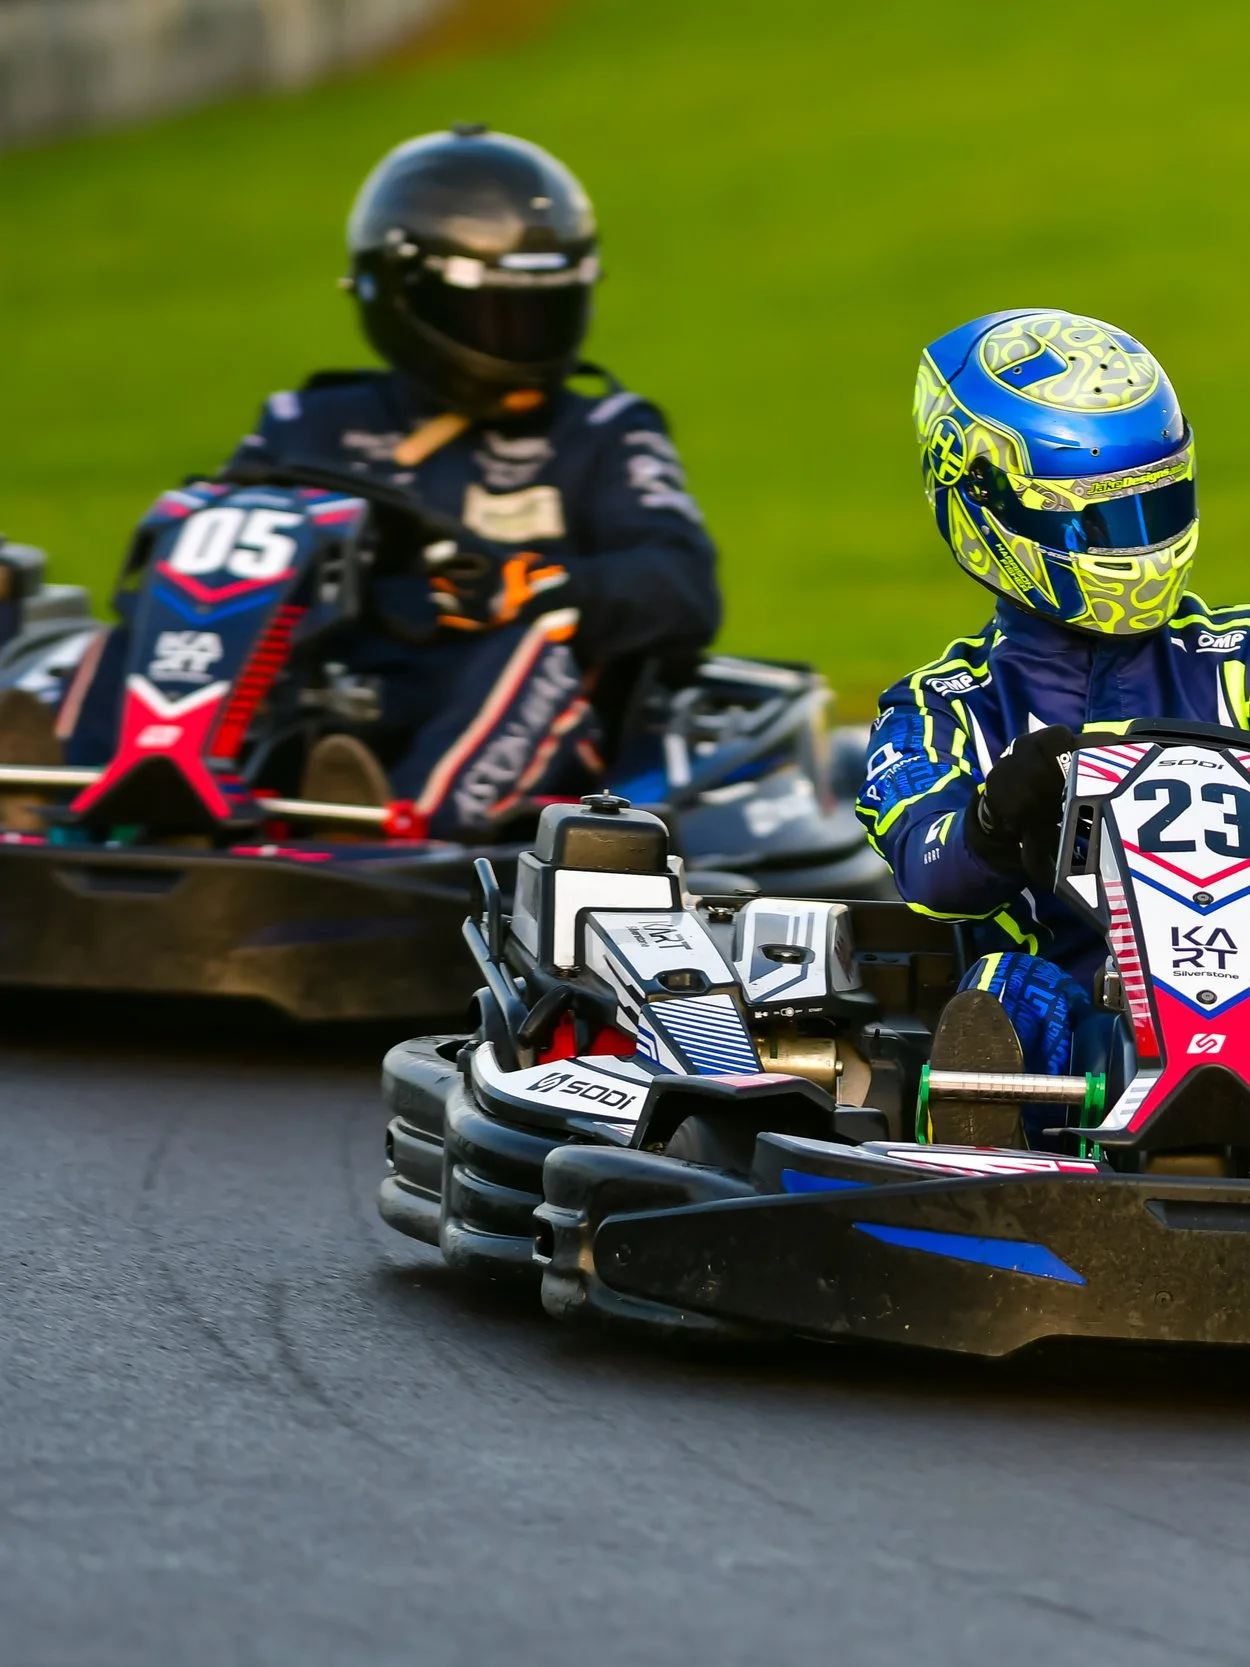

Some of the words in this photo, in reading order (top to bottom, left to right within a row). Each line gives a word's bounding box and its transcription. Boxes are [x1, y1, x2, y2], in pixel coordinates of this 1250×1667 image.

[170, 507, 304, 579] 05
[1198, 632, 1245, 649] OMP
[930, 674, 974, 693] OMP
[1172, 970, 1240, 980] Silverstone
